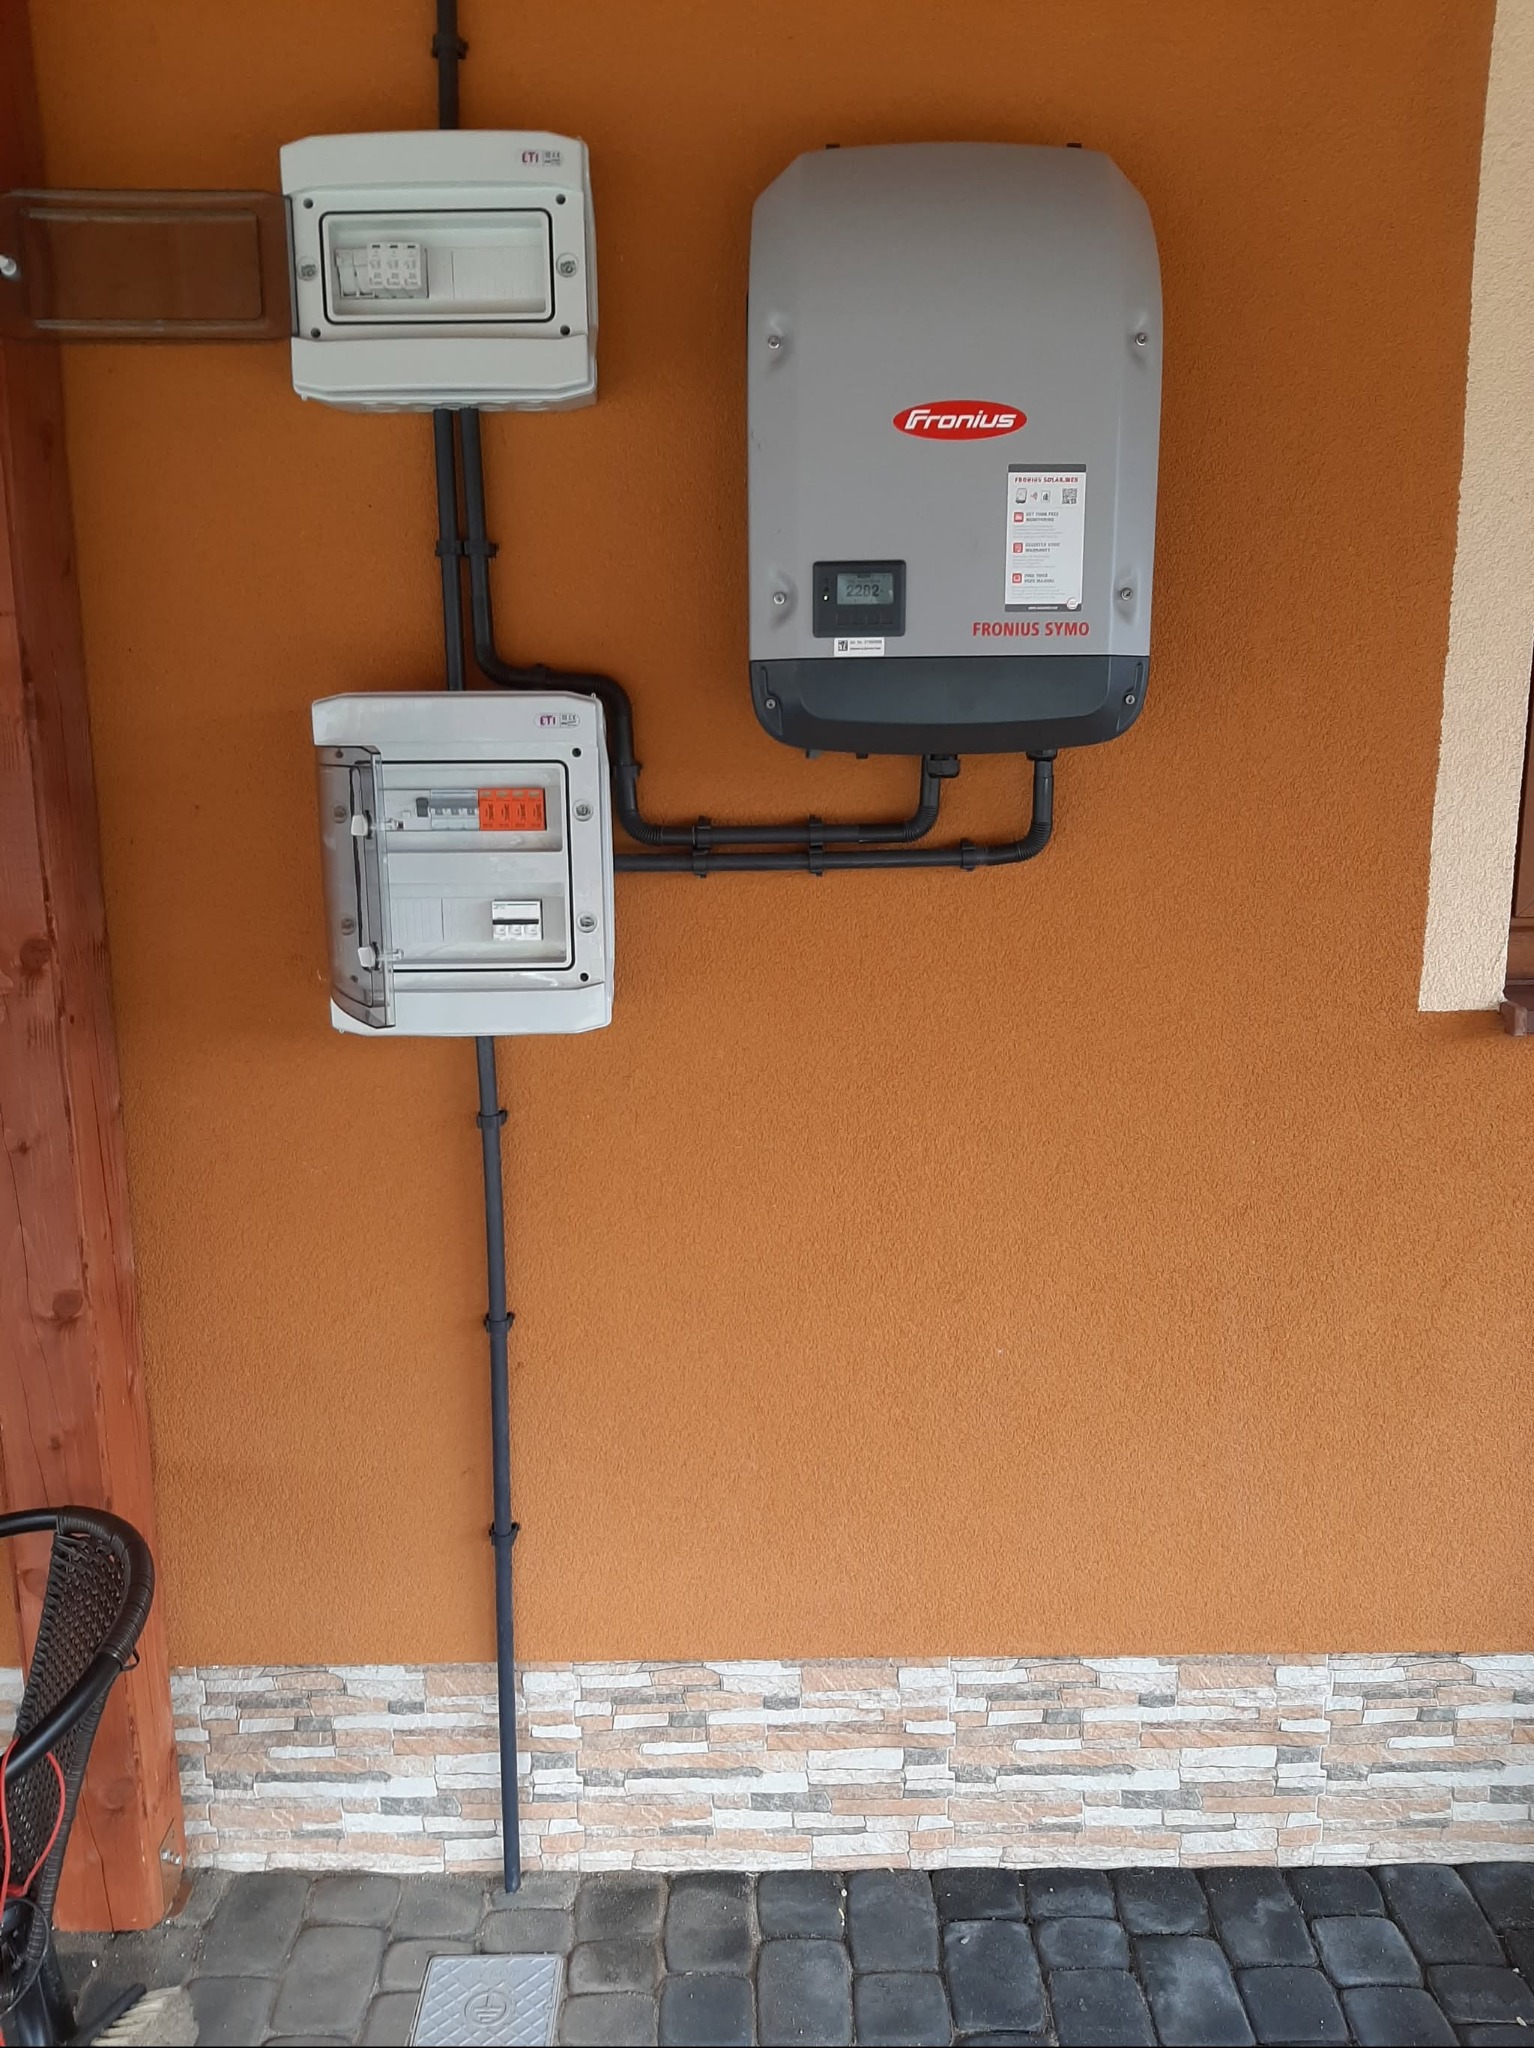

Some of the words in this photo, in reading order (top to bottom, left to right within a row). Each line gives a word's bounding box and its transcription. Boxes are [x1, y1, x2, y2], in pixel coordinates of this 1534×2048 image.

[904, 409, 1017, 429] Fronius
[846, 584, 880, 597] 2202
[972, 622, 1040, 636] FRONIUS
[1044, 622, 1090, 636] SYMO
